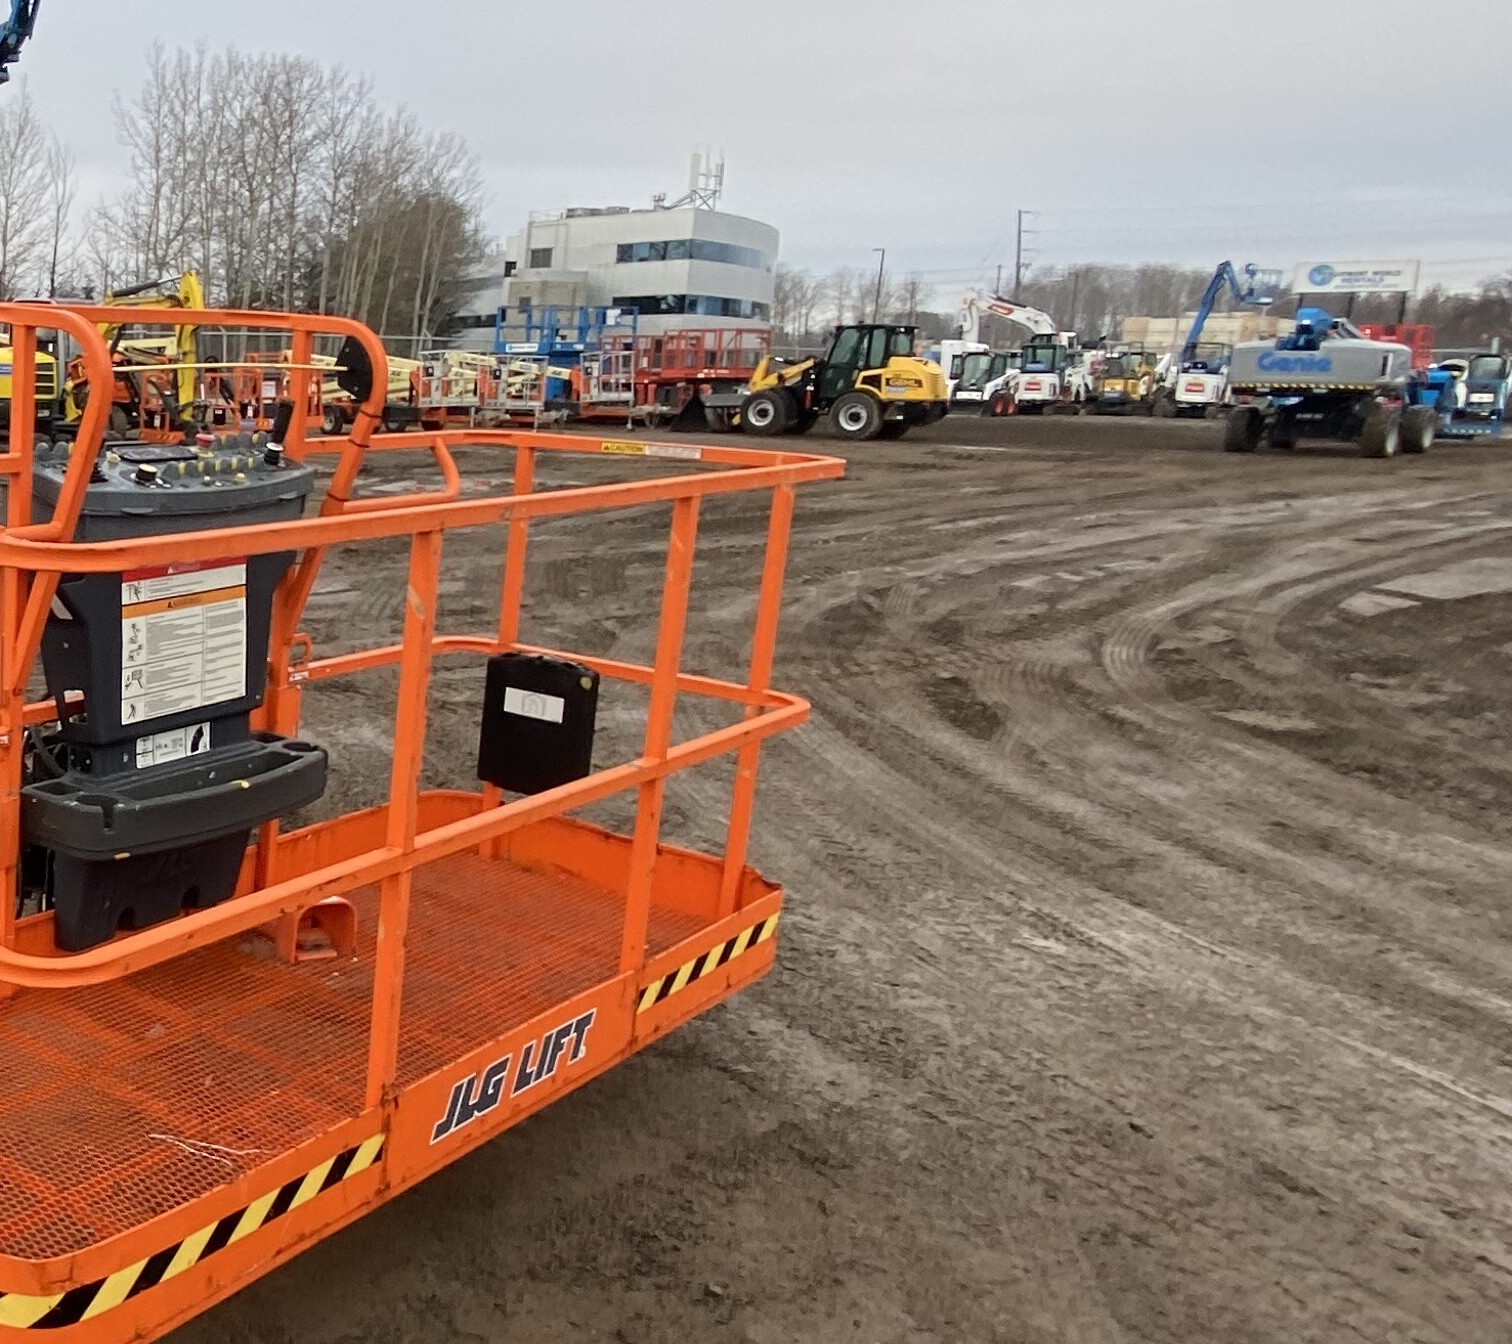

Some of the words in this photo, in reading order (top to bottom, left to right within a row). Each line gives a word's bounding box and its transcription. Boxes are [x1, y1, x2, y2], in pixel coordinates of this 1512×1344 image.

[1257, 352, 1332, 371] Genie
[429, 1052, 513, 1145] JLG
[510, 1007, 598, 1099] LIFT
